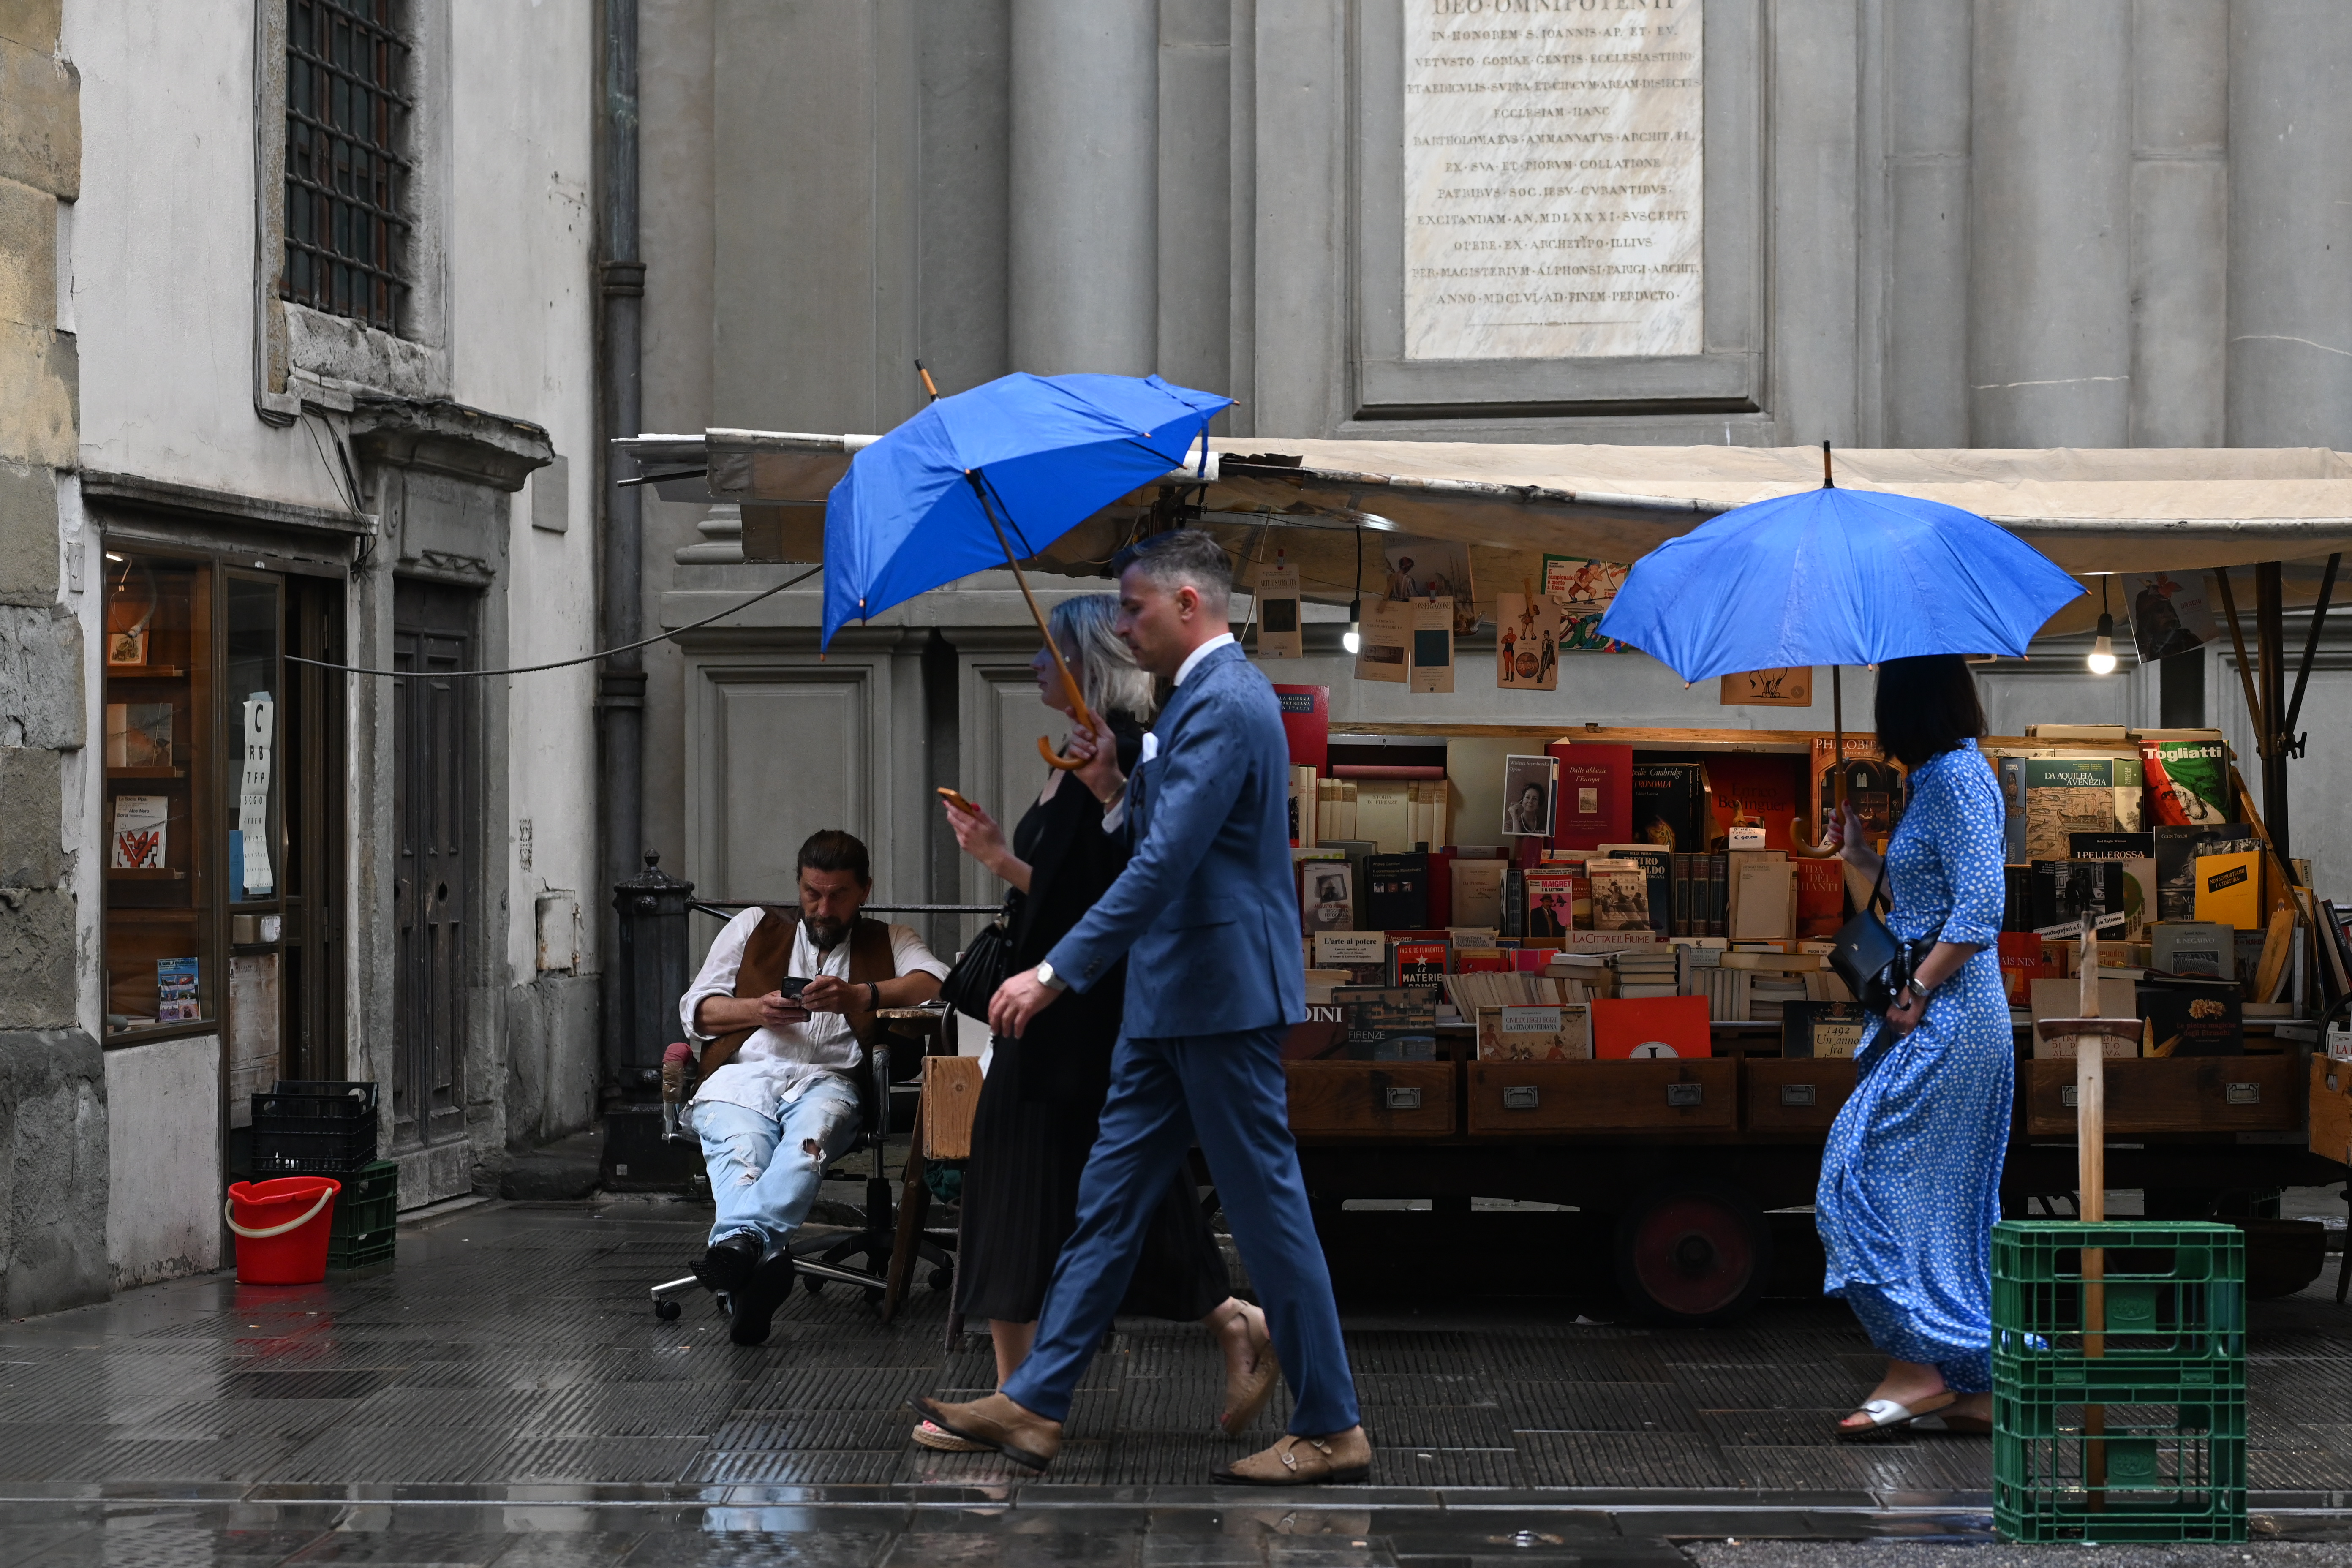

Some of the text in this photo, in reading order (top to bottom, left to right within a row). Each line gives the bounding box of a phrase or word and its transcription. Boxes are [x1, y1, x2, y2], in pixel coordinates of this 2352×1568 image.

[1432, 31, 1445, 41] IN
[1452, 30, 1518, 40] HONOREM
[1579, 159, 1661, 169] COLLATIONE
[1417, 214, 1507, 226] EXCITANDAM
[1436, 293, 1477, 305] ANNO
[2180, 599, 2202, 609] DRAGHI
[255, 704, 263, 733] C
[2142, 746, 2222, 762] Togliatti
[1650, 768, 1682, 779] Cambridge
[2057, 772, 2093, 781] AQUILEIA
[1576, 776, 1600, 784] l'Europa
[1732, 783, 1777, 797] Enrico
[2082, 850, 2145, 859] PELLEROSSA
[1810, 874, 1833, 883] DEL
[2219, 868, 2245, 882] SOPPORTIAMO
[2104, 915, 2122, 924] Toscana
[1355, 938, 1377, 946] potere
[1573, 933, 1585, 943] LA
[1624, 933, 1650, 943] FIUME
[2017, 958, 2036, 966] NIN
[1402, 973, 1443, 983] MATERIE
[2208, 1021, 2237, 1030] magiche
[1348, 1031, 1386, 1040] FIRENZE
[1827, 1027, 1850, 1037] 1492
[2183, 1029, 2200, 1038] degli
[1817, 1034, 1832, 1044] Un
[1827, 1043, 1843, 1056] fra
[2336, 1045, 2348, 1054] LA
